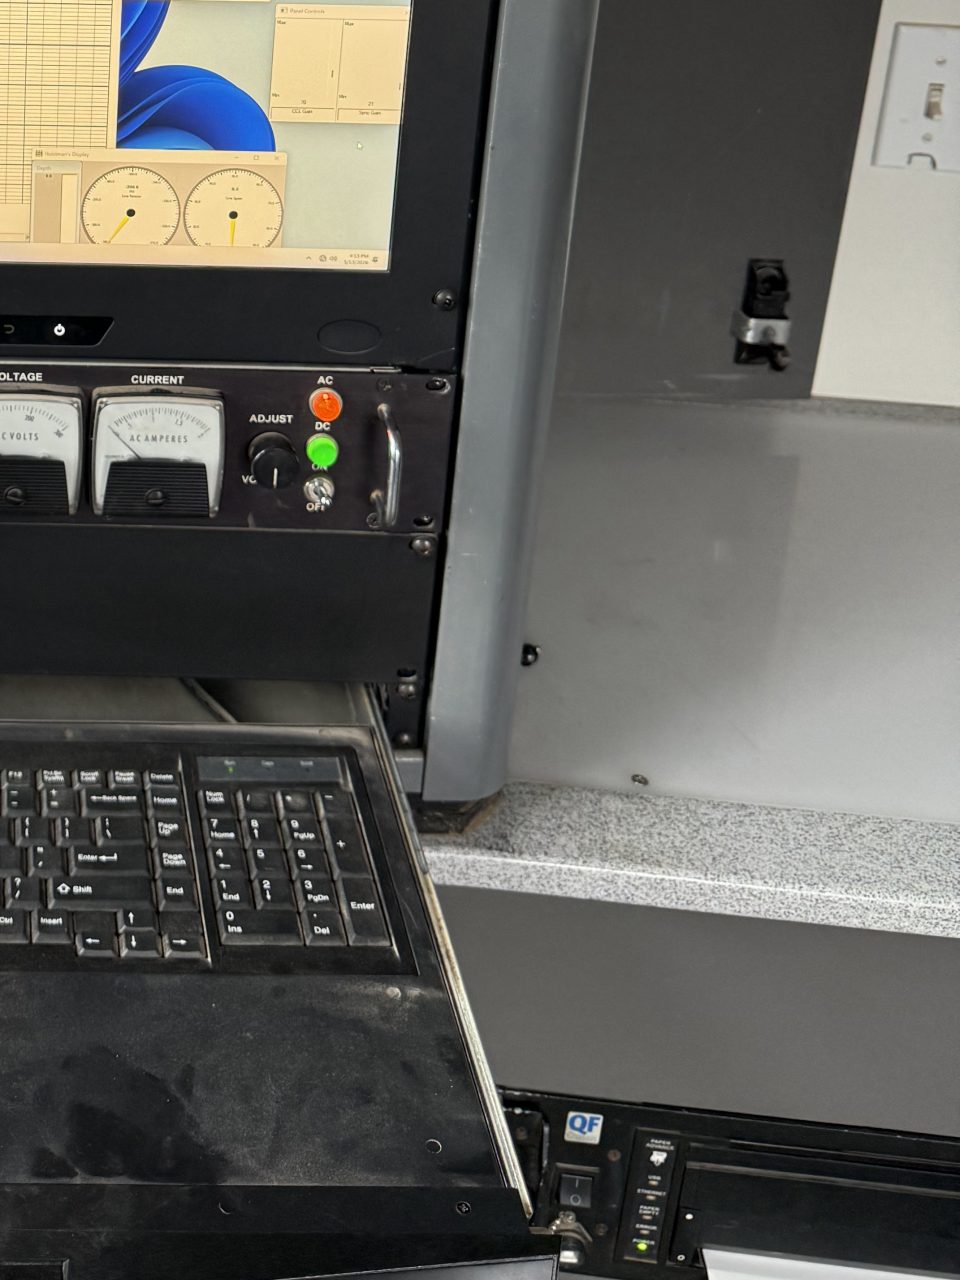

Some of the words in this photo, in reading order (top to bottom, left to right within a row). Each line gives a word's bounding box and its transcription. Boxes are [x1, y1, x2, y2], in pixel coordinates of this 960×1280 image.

[131, 375, 184, 385] CURRENT
[317, 375, 334, 385] AC
[249, 414, 294, 424] ADJUST
[314, 421, 331, 431] DC
[9, 432, 39, 441] VOLTS
[129, 434, 141, 442] AC
[143, 434, 188, 443] AMPERES
[166, 886, 184, 895] End
[350, 901, 375, 911] Enter
[313, 926, 330, 935] Del
[568, 1114, 600, 1135] QF
